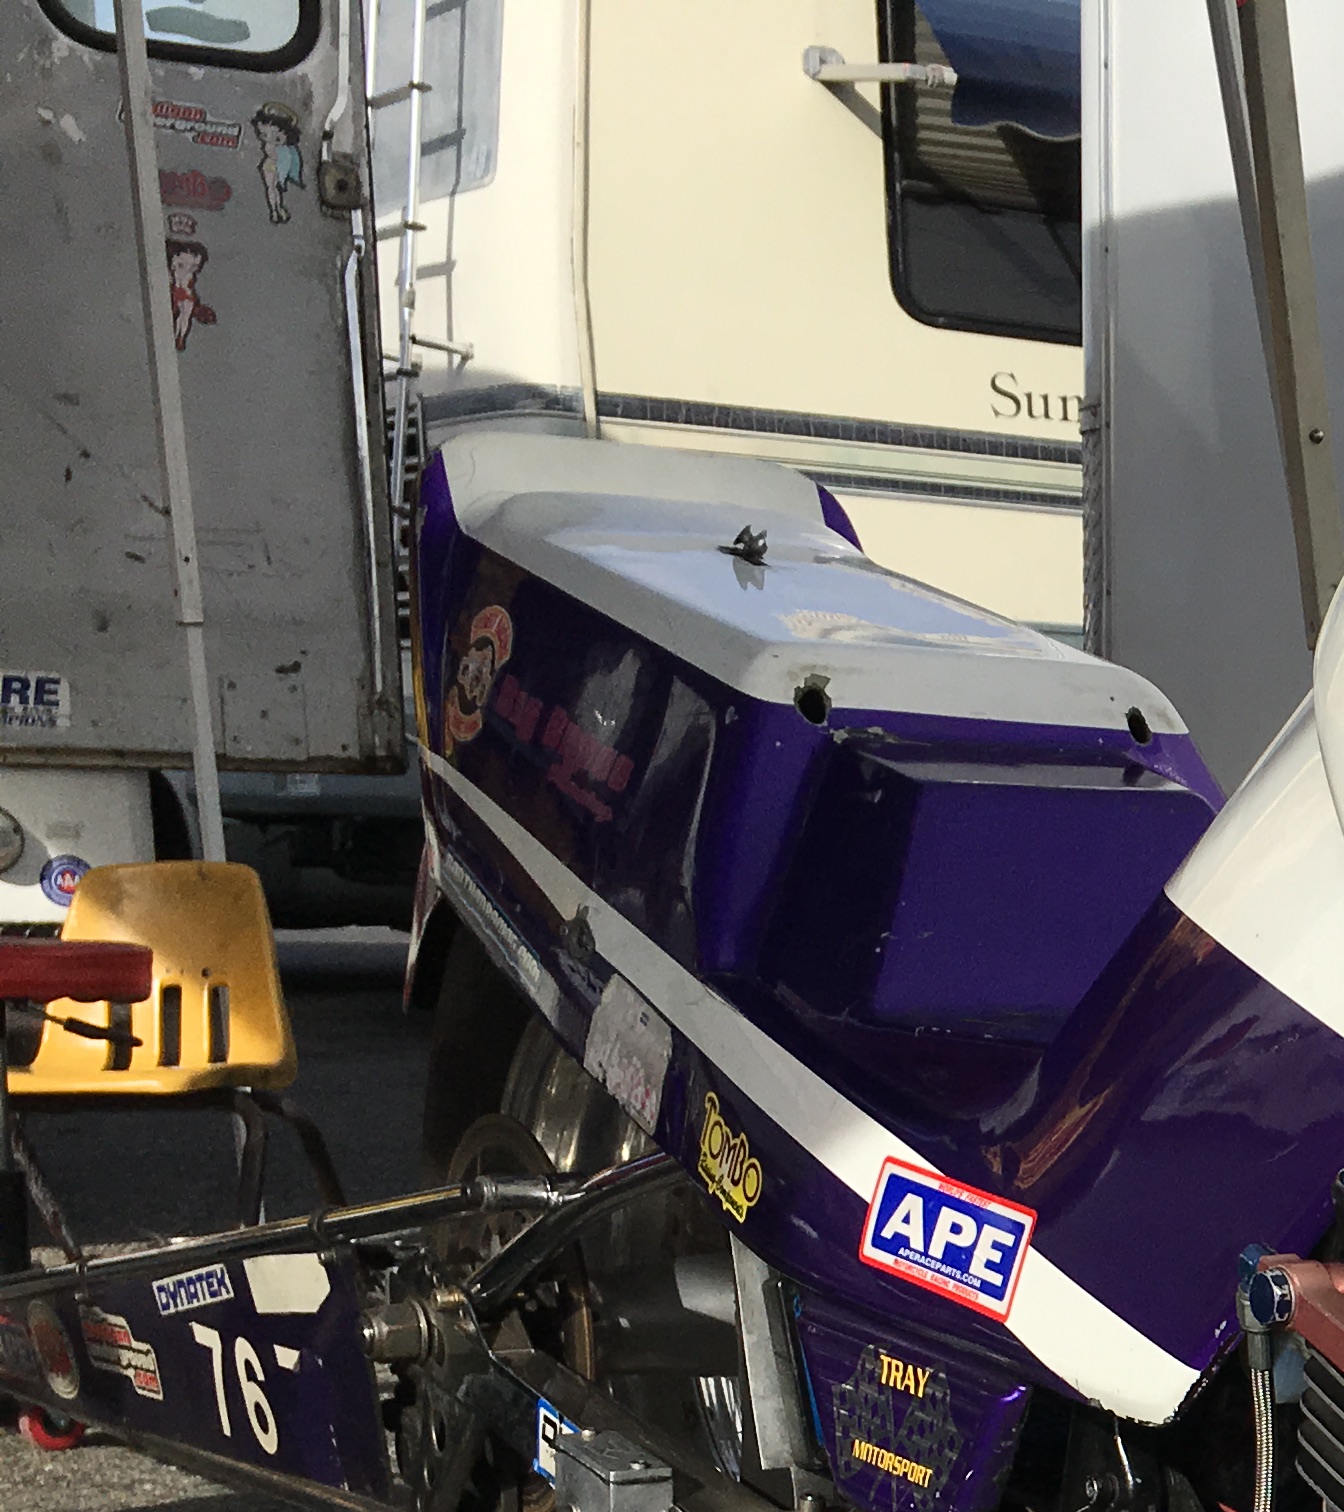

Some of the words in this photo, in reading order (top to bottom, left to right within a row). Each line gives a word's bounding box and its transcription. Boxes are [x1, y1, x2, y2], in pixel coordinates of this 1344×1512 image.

[1, 675, 61, 706] RE
[702, 1096, 760, 1203] TOMBO
[880, 1192, 1016, 1287] APE
[156, 1267, 230, 1311] DYNATEK
[898, 1247, 981, 1288] APERACEPARTS.COM
[189, 1321, 278, 1455] 76
[880, 1354, 930, 1398] TRAY
[852, 1439, 933, 1488] MOTORSPORT
